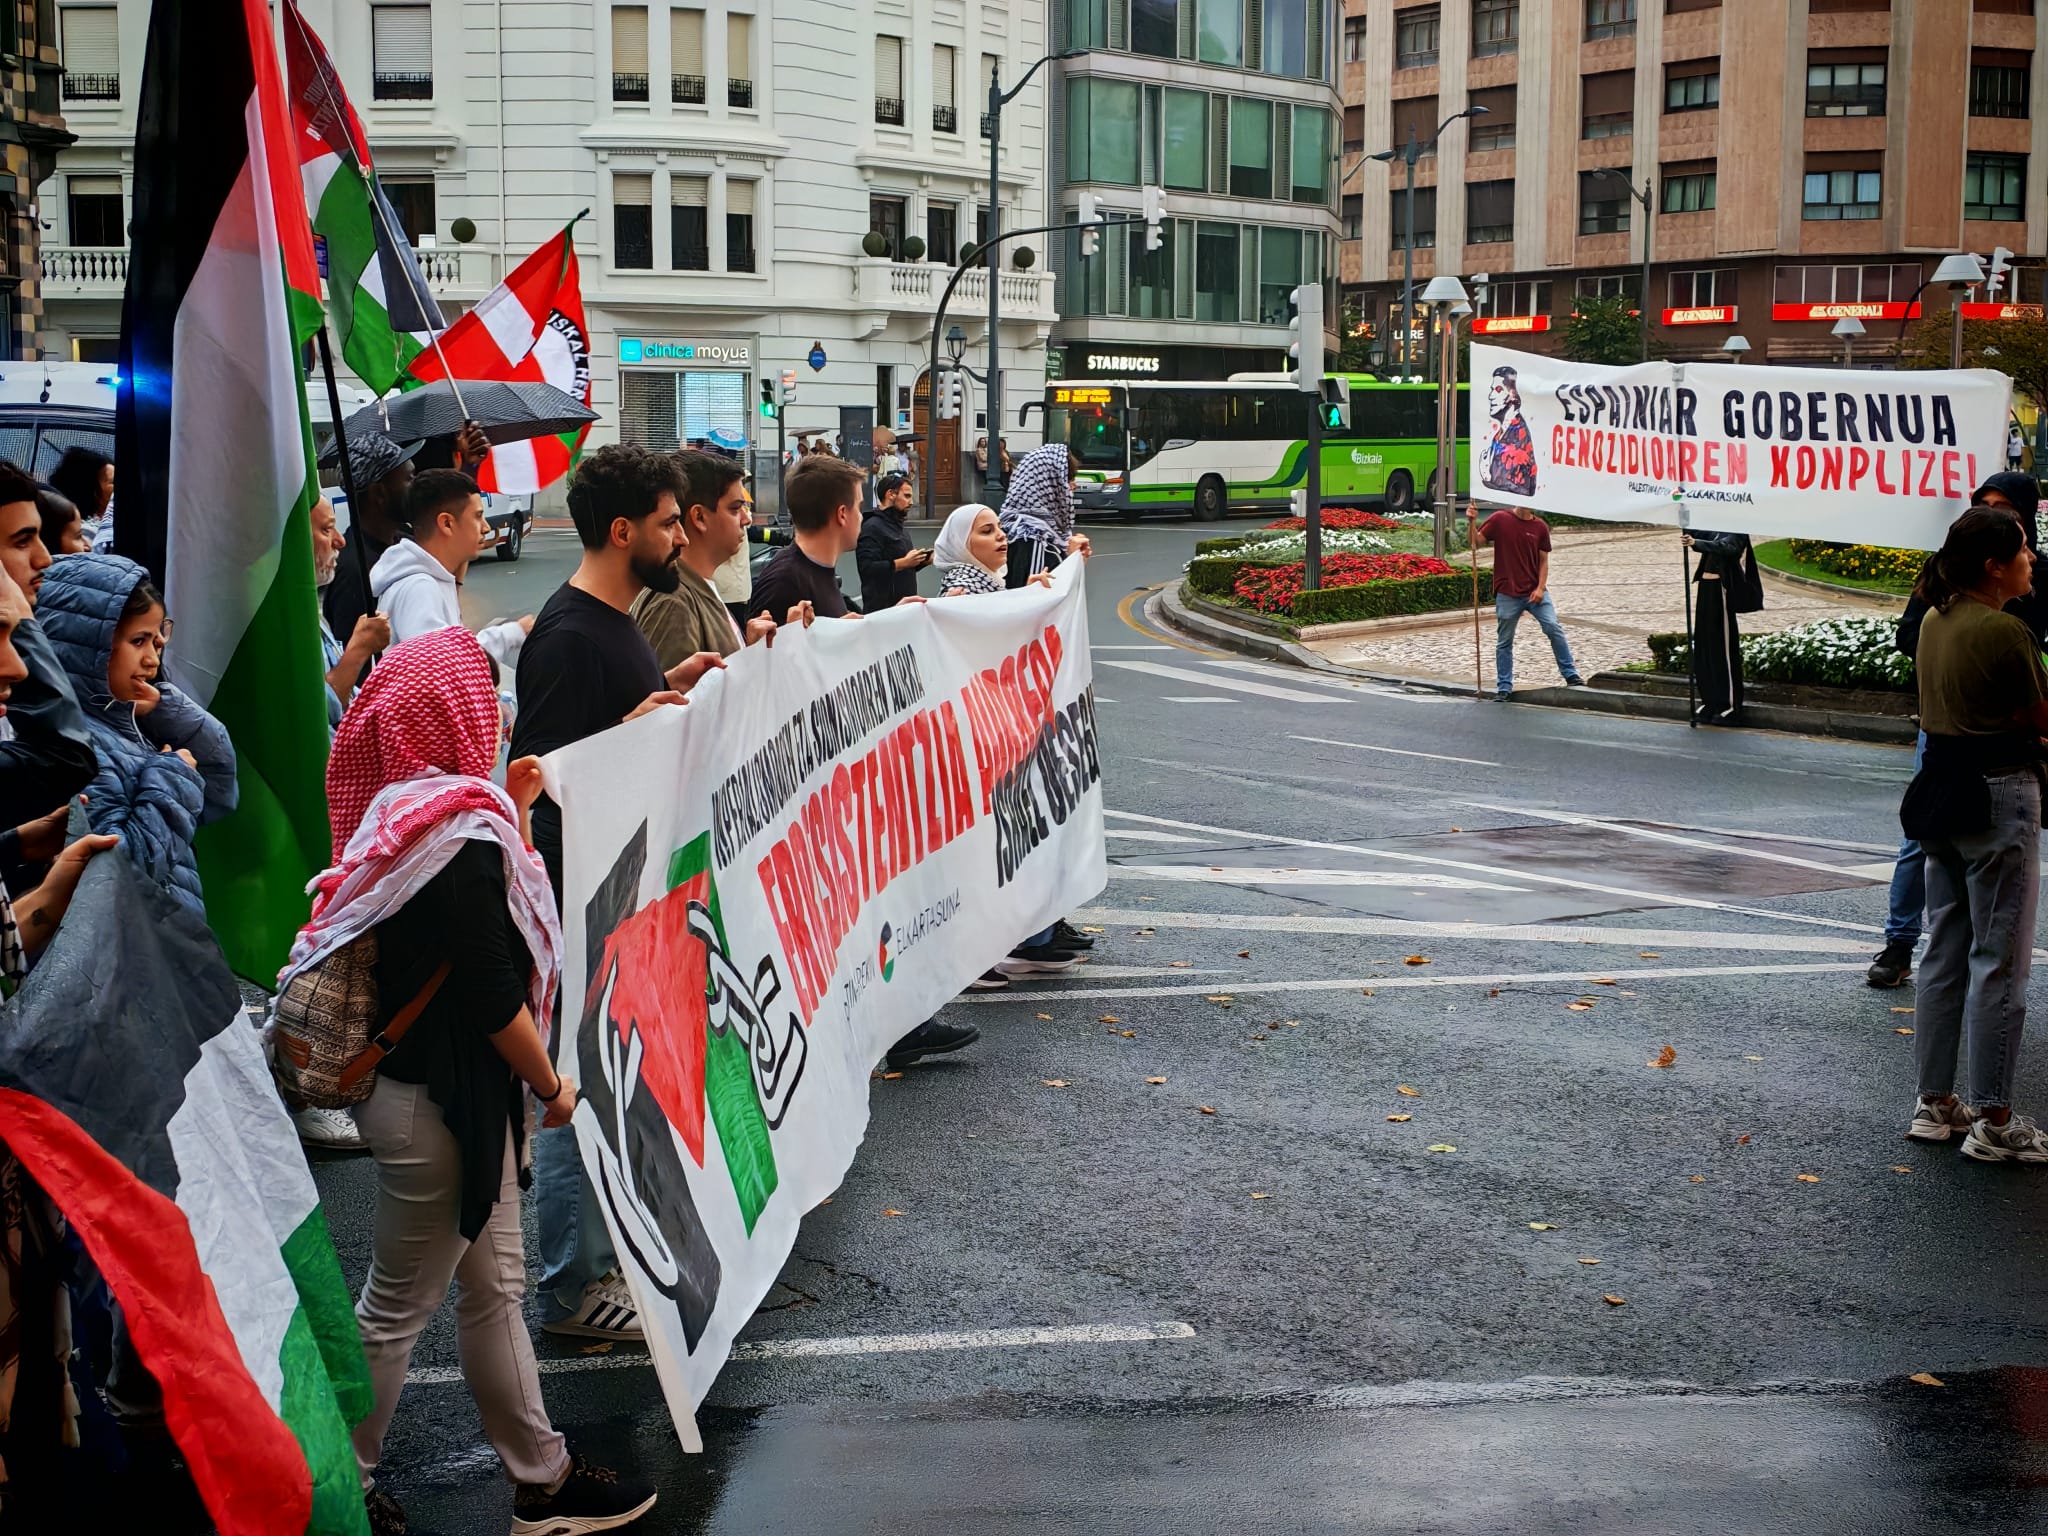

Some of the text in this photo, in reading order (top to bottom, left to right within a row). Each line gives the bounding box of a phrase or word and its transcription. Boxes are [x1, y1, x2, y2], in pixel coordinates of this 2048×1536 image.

[1827, 305, 1883, 317] GENERALI
[1394, 329, 1425, 340] LIRE
[697, 346, 748, 362] moyua
[1087, 355, 1160, 372] STARBUCKS
[1555, 383, 1957, 447] ESPAINIAR GOBERNUA
[1551, 424, 1977, 499] GENOZIDIOAREN KONPLIZE!
[1686, 489, 1754, 505] ELKARTASUNA
[885, 643, 926, 715] AURKA
[895, 888, 961, 957] ELKARTASUNA
